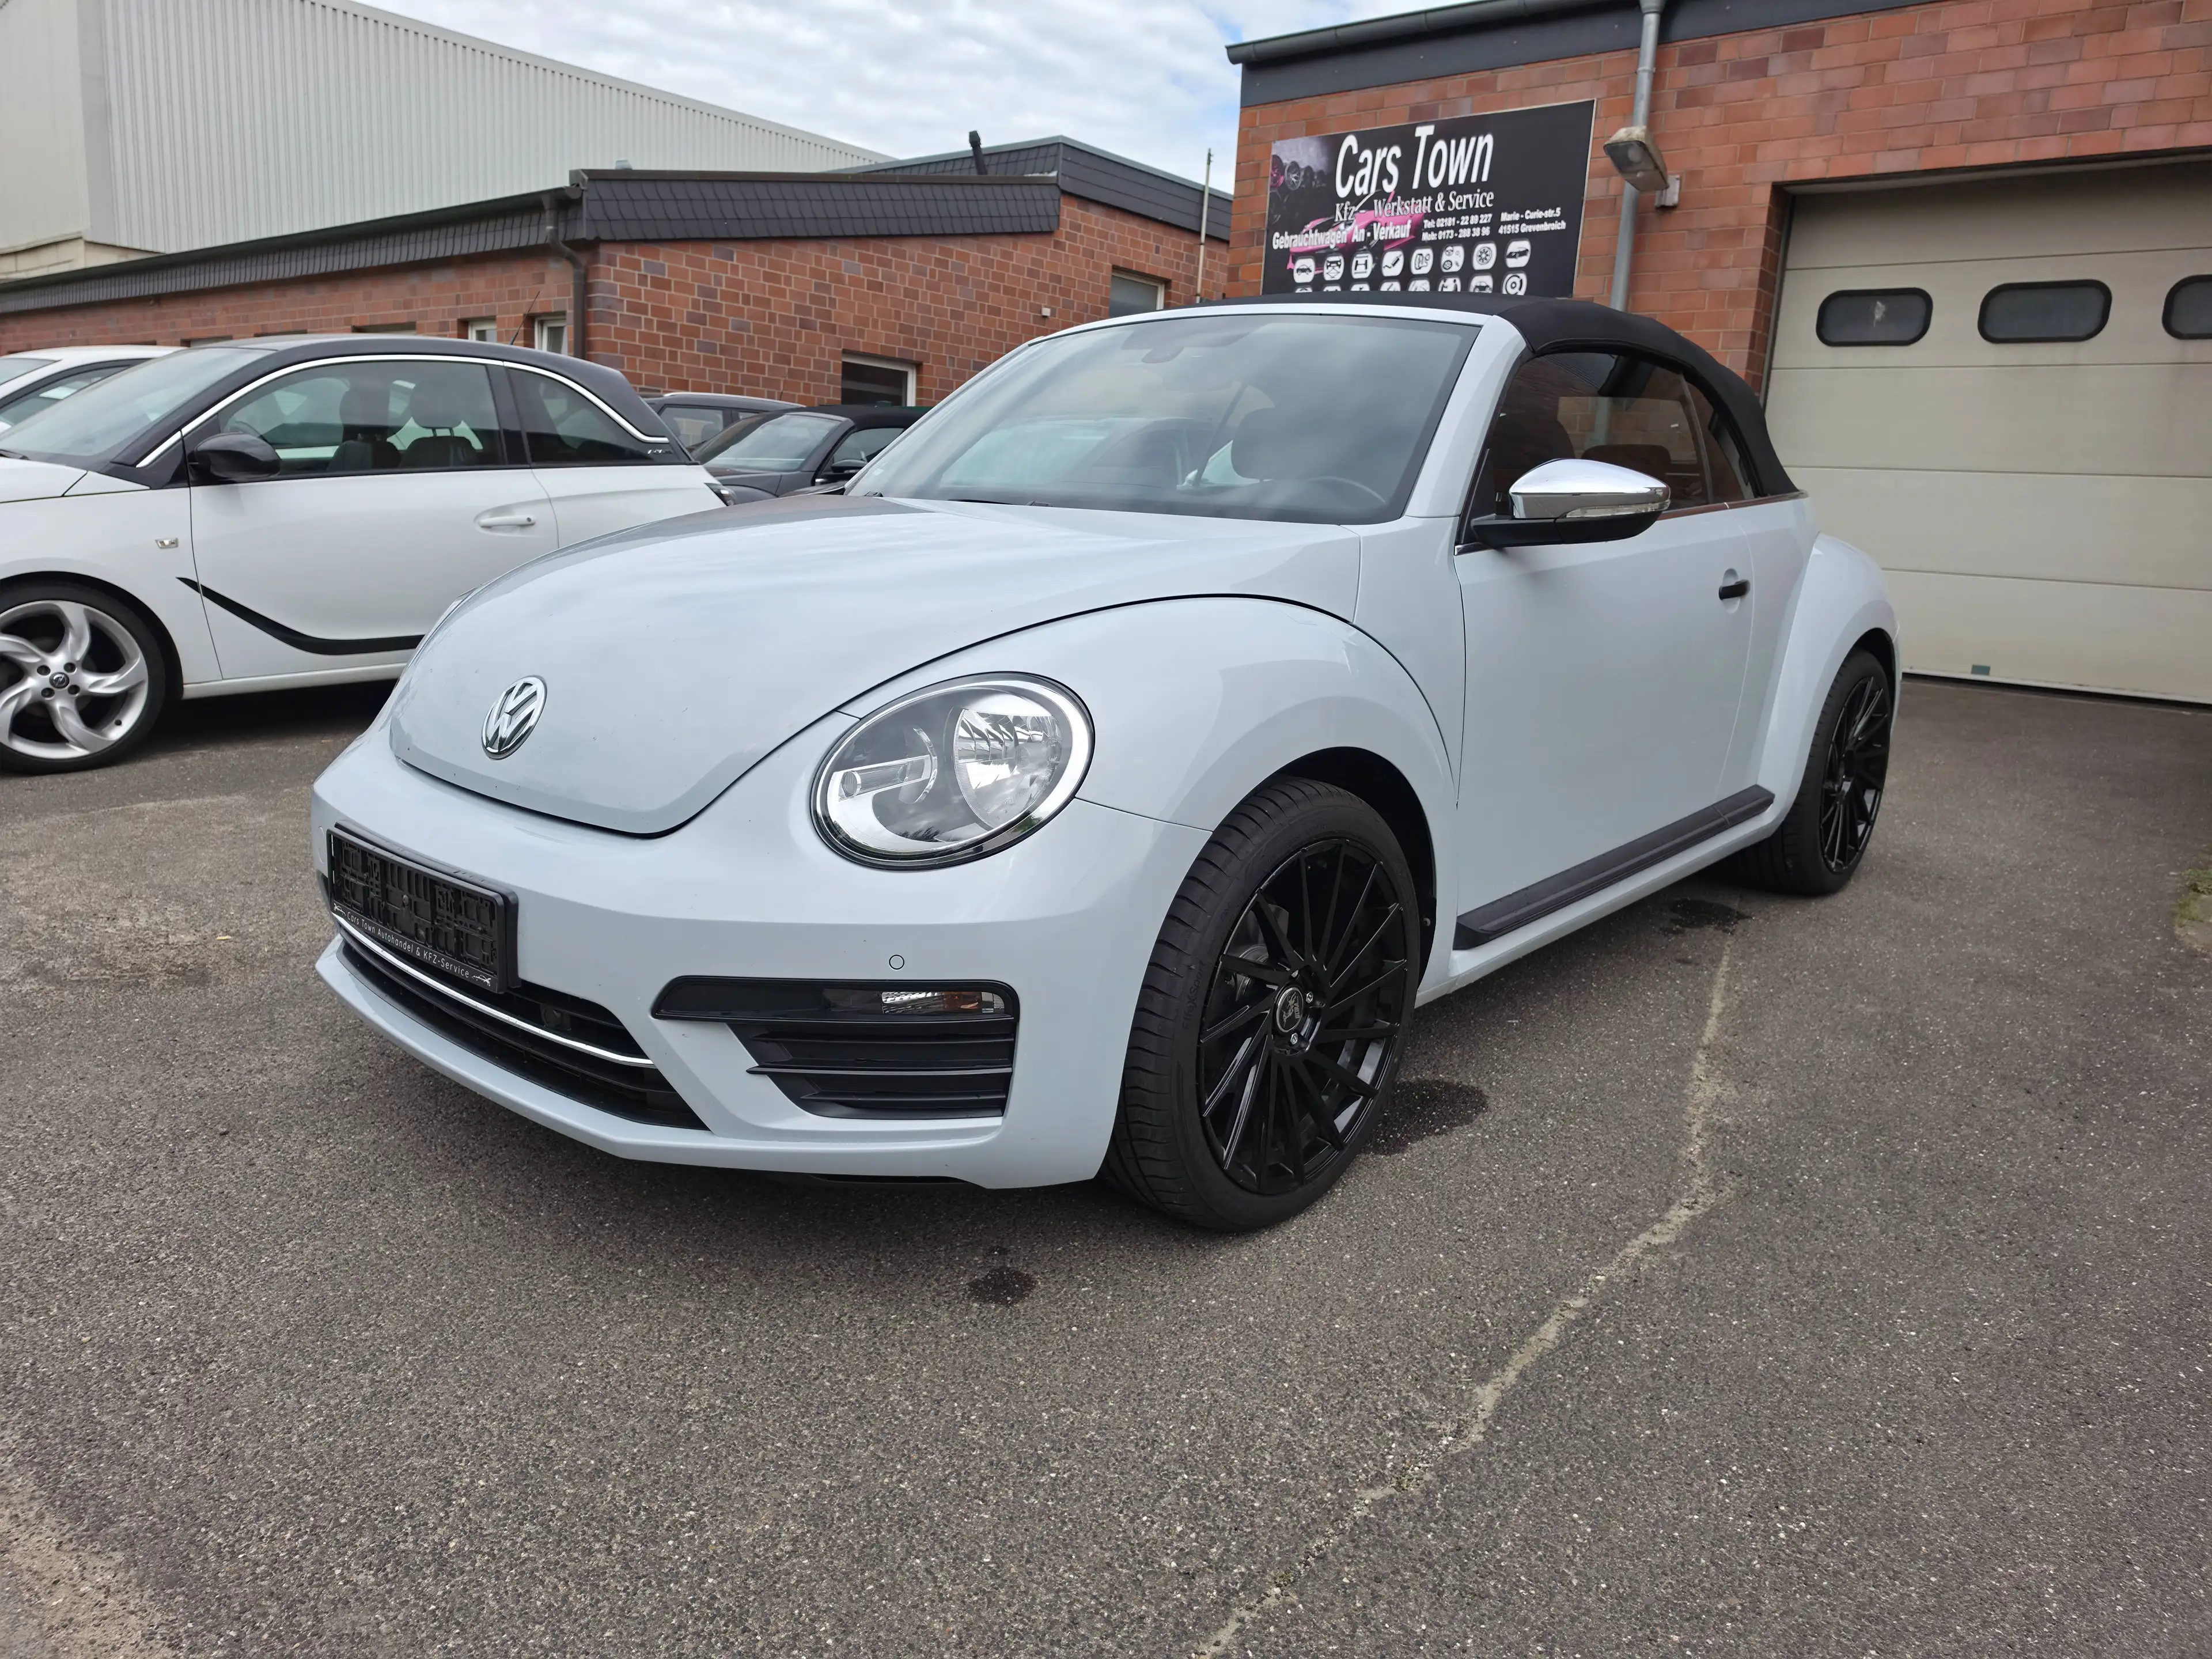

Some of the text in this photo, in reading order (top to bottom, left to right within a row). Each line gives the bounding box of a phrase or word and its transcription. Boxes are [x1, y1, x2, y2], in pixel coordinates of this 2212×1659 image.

[1335, 124, 1494, 198] Cars Town
[1334, 201, 1356, 222] Kfz
[1373, 196, 1433, 218] Werkstatt
[1434, 192, 1445, 212] &
[1448, 189, 1494, 211] Service
[1500, 211, 1520, 222] Marie
[1460, 215, 1469, 225] 22
[1498, 219, 1566, 234] 41515 Grevenbroich
[1272, 229, 1347, 249] Gebrauchtwagen
[1351, 226, 1365, 243] An
[1373, 219, 1411, 240] Verkauf
[1438, 229, 1454, 240] 0173
[347, 911, 469, 978] Cars Town Autohandel & KFZ-Service
